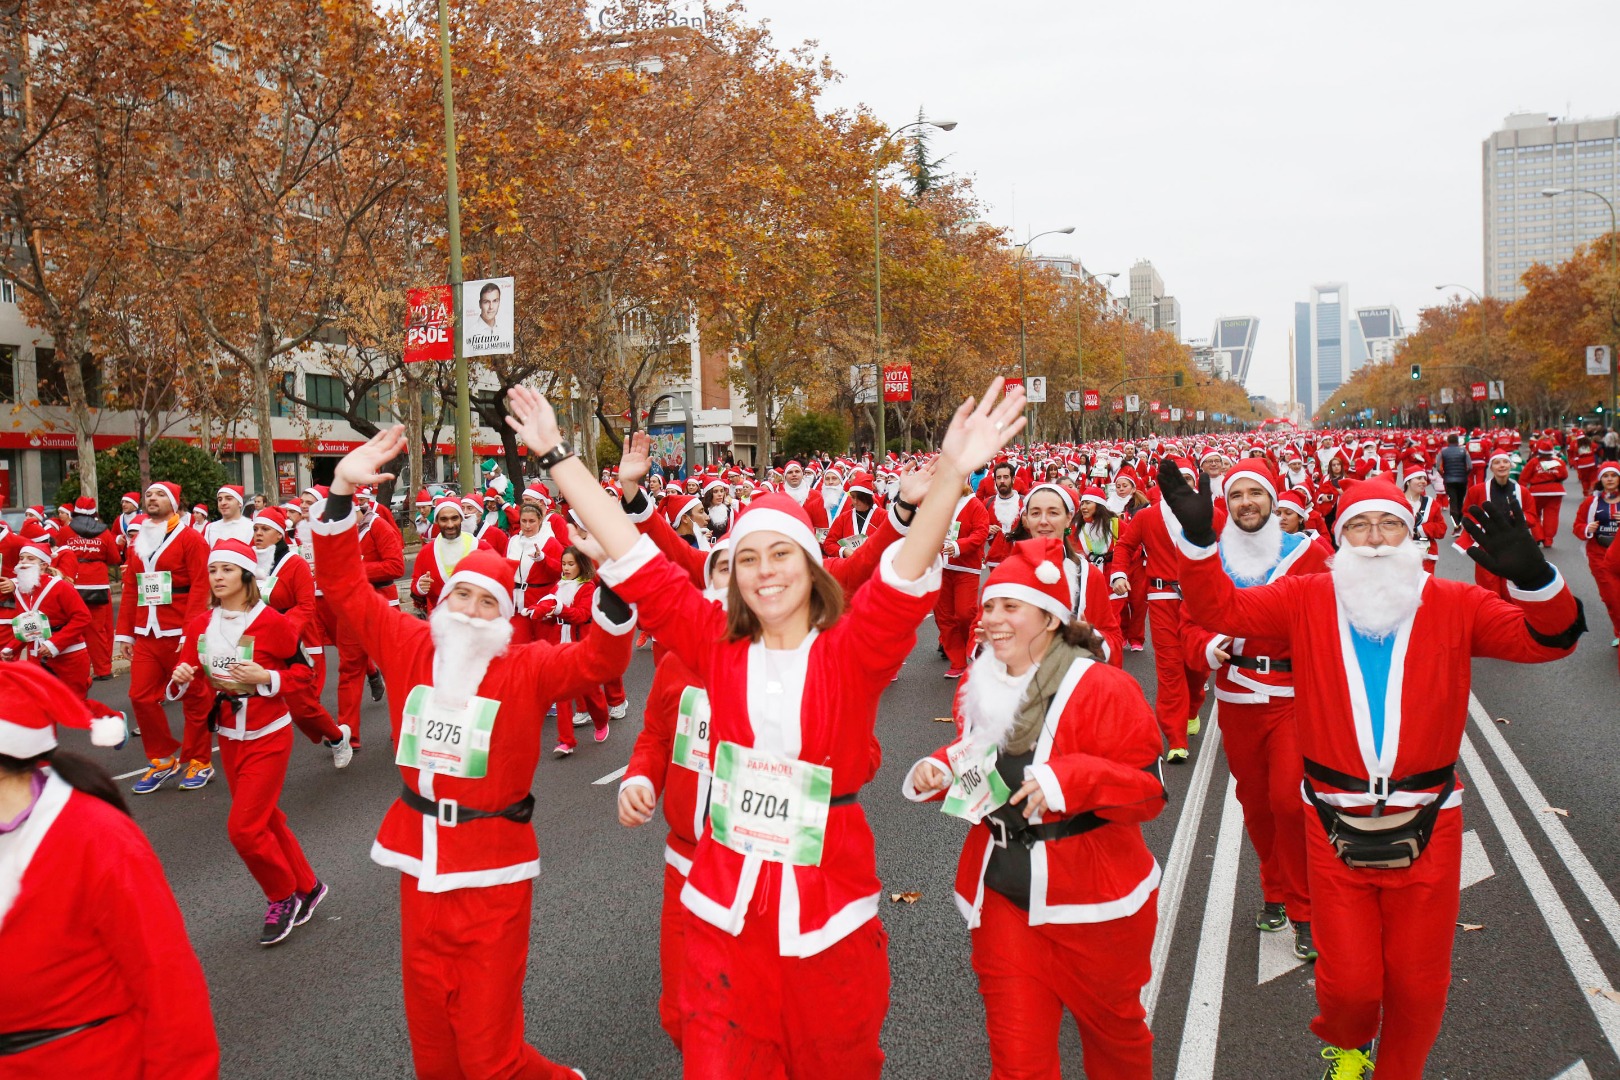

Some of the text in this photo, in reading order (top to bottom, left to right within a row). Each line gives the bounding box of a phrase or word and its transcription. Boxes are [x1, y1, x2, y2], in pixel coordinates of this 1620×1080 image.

[598, 7, 709, 29] CxaBan
[408, 327, 448, 346] PSOE
[471, 335, 500, 346] futuro
[885, 371, 909, 381] VOTA
[885, 382, 909, 392] PSOE
[42, 436, 79, 447] Santand
[324, 442, 350, 451] Santander
[74, 538, 102, 546] NAVIDAD
[426, 720, 462, 745] 2375
[698, 721, 710, 740] 8
[960, 765, 982, 795] 8703
[742, 790, 788, 821] 8704
